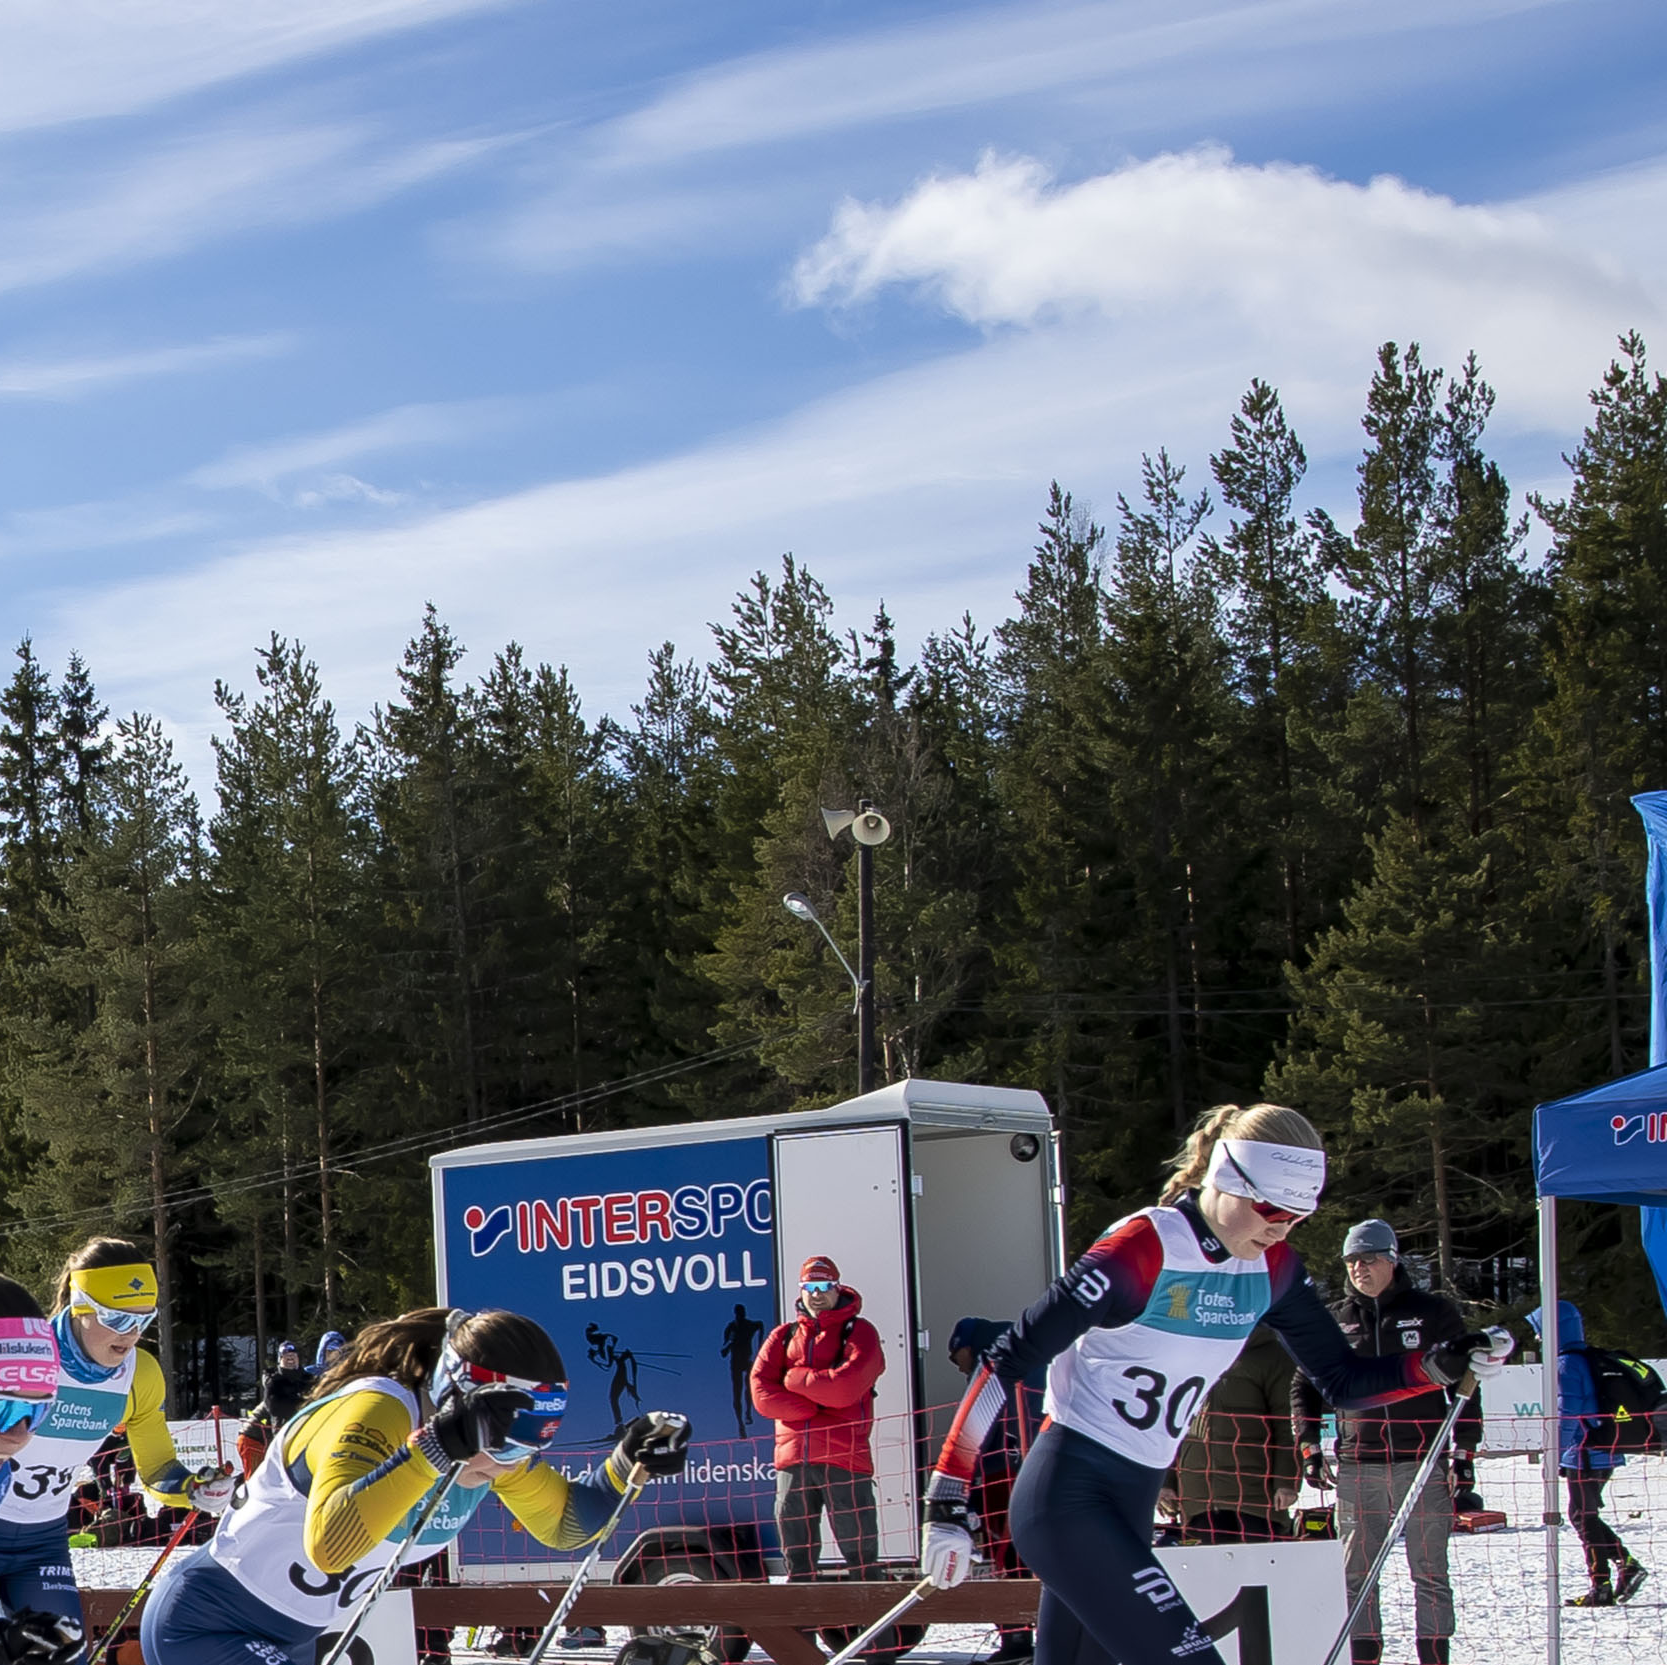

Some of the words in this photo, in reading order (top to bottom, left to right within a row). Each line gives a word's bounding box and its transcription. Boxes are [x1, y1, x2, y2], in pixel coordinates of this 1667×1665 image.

[562, 1251, 767, 1301] EIDSVOLL
[1197, 1289, 1235, 1308] Totens
[1195, 1307, 1257, 1327] Sparebank
[55, 1400, 93, 1417] Totens
[50, 1413, 109, 1430] Sparebank
